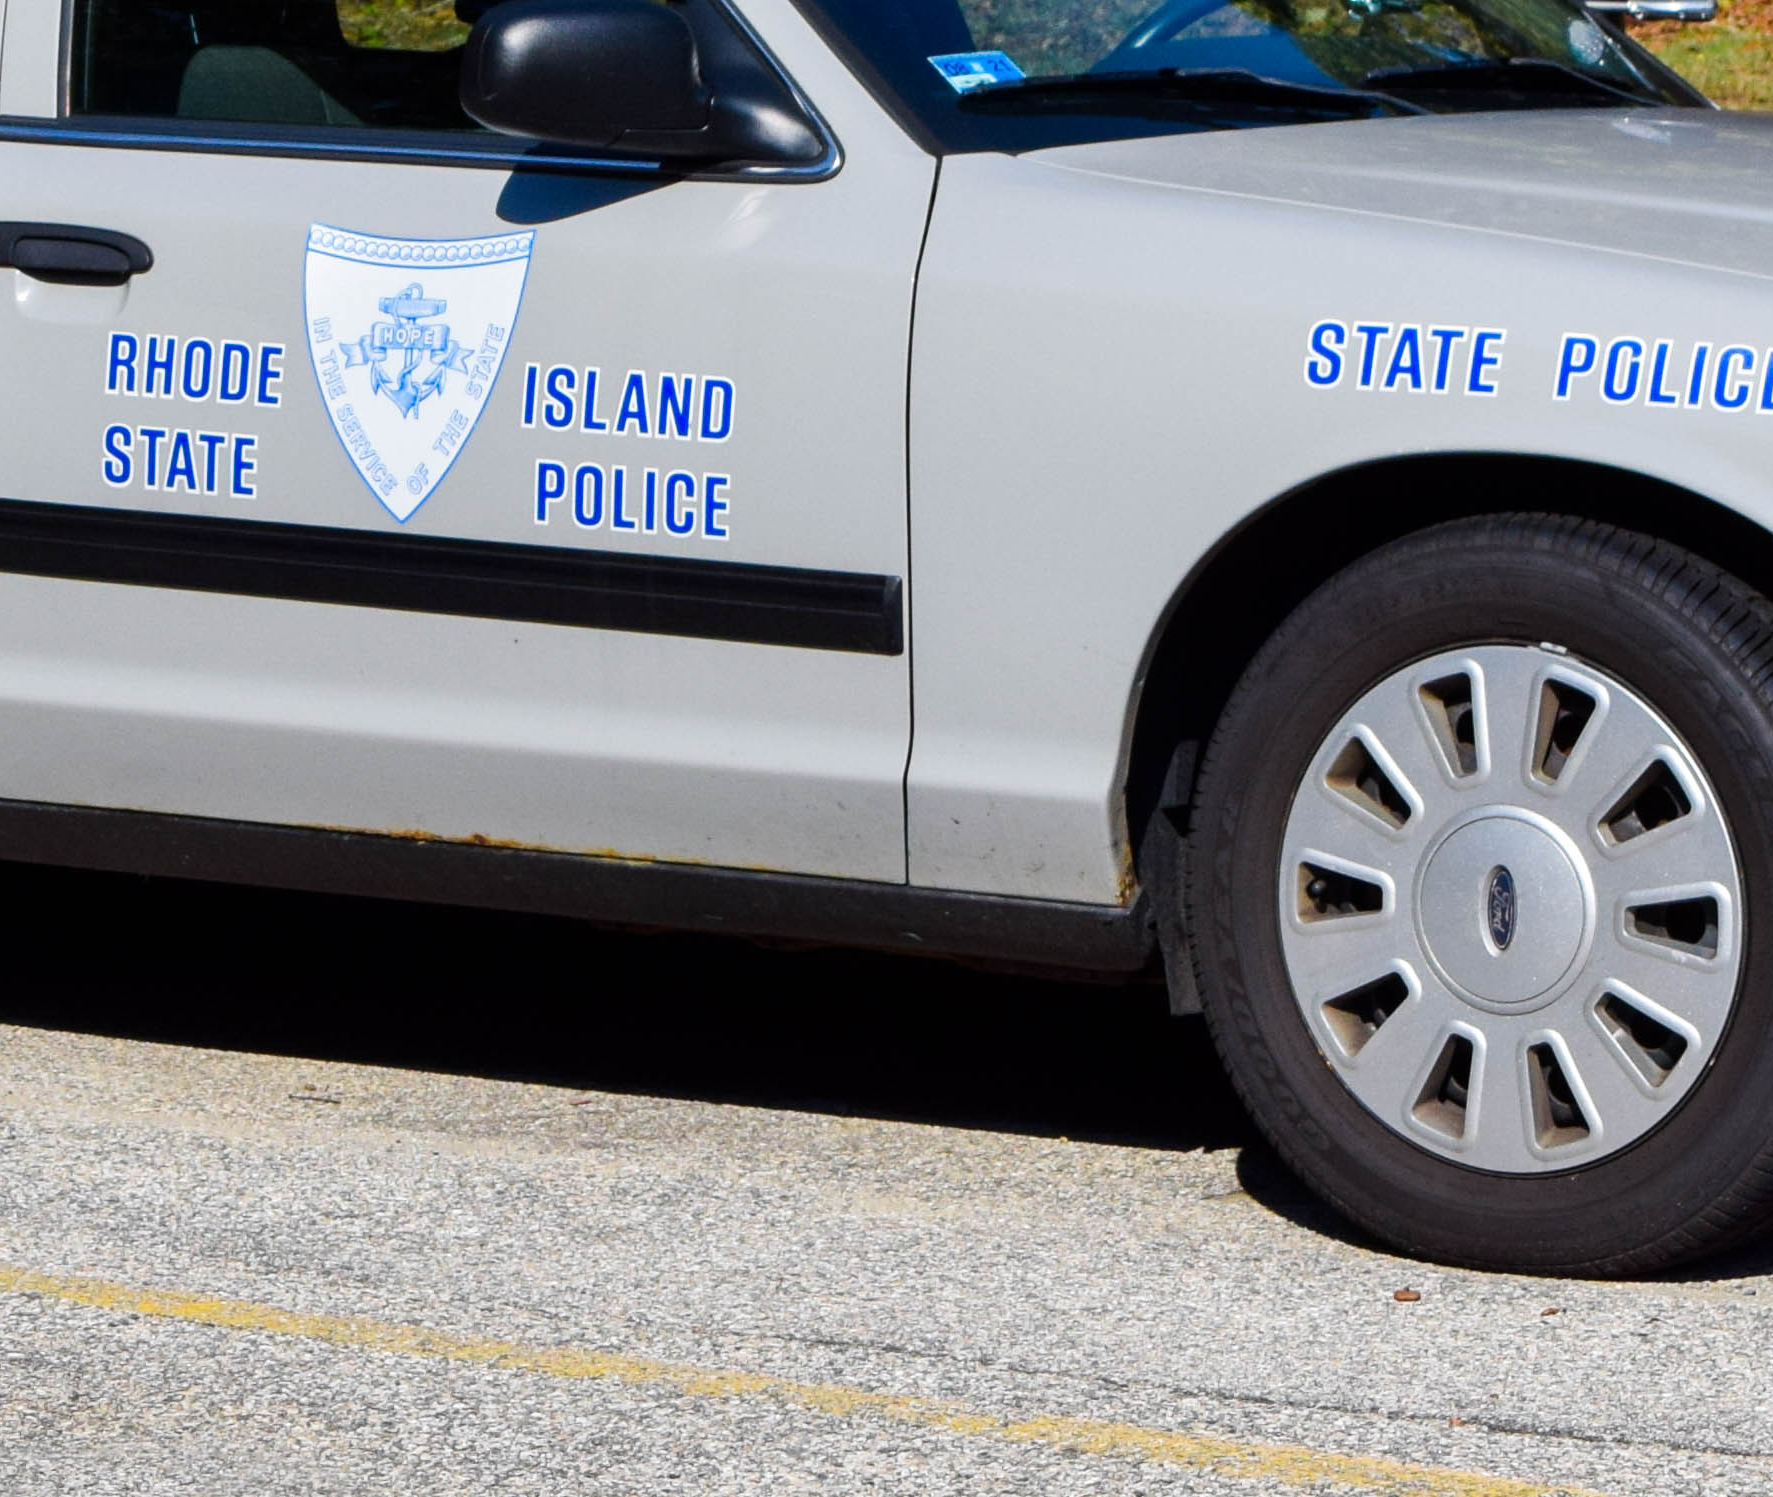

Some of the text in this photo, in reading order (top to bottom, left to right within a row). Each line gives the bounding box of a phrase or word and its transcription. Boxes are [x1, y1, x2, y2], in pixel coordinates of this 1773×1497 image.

[104, 330, 286, 408] RHODE
[382, 327, 435, 347] HOPE
[1303, 319, 1507, 398] STATE
[313, 316, 506, 497] IN THE SERVICE OF THE STATE
[521, 362, 736, 444] ISLAND
[102, 422, 259, 500] STATE
[534, 458, 732, 541] POLICE
